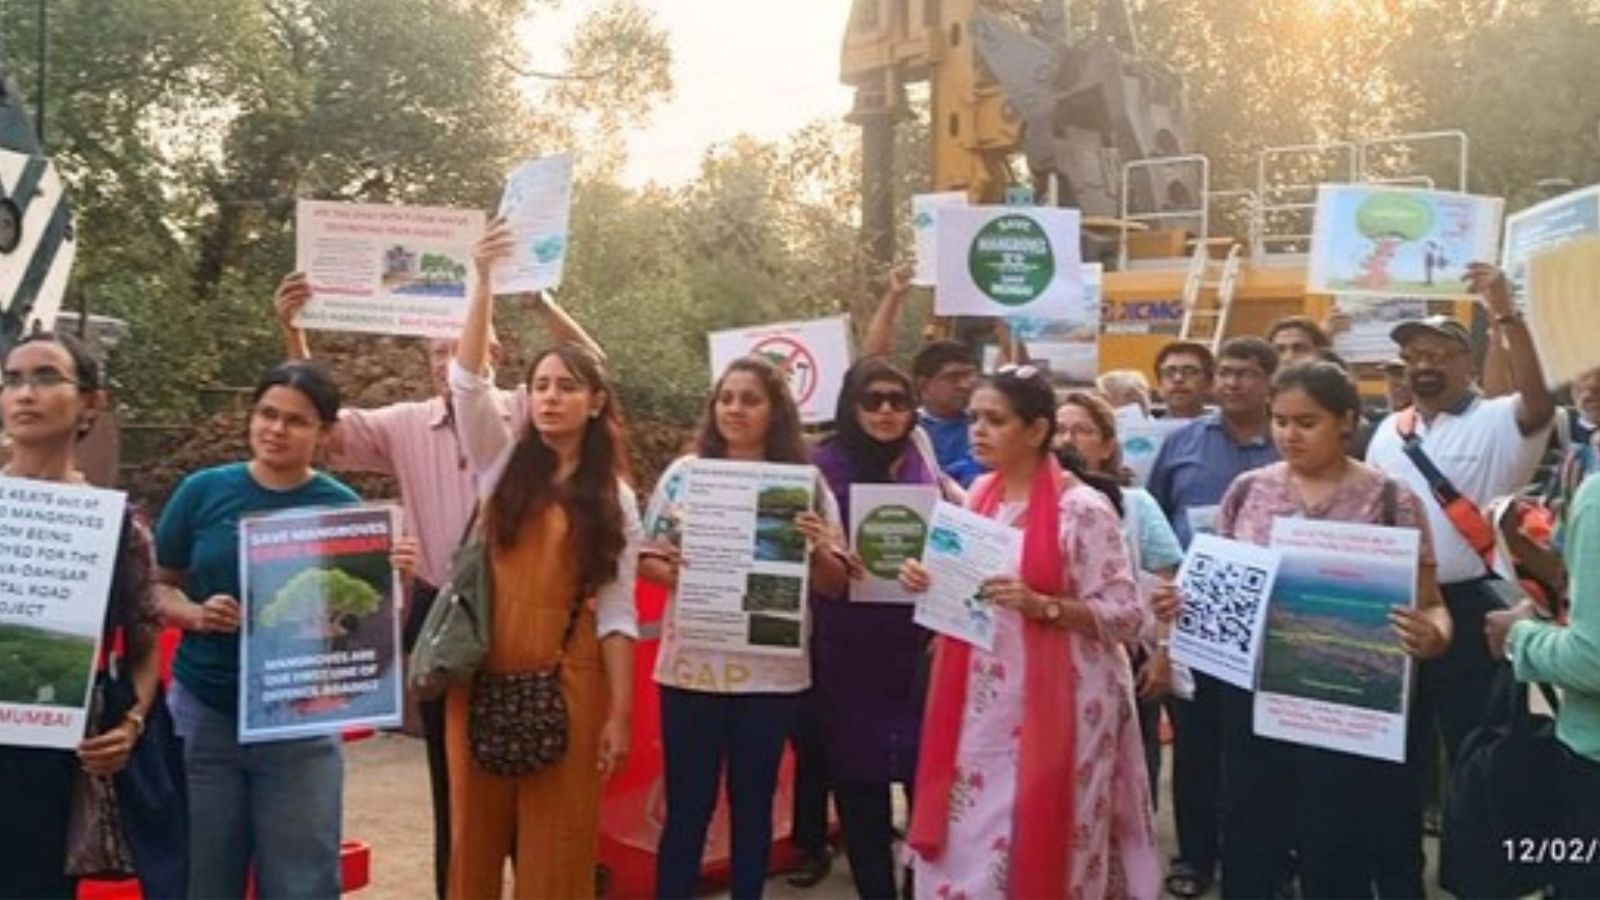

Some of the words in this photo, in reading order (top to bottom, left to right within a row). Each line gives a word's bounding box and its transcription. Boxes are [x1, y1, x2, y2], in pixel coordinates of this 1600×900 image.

[998, 221, 1031, 233] SAVE
[11, 506, 105, 530] MANGROVES
[25, 526, 73, 544] BEING
[250, 529, 290, 547] SAVE
[292, 523, 388, 541] MANGROVES
[37, 545, 67, 562] FOR
[70, 548, 100, 567] THE
[28, 584, 72, 601] ROAD
[673, 655, 750, 689] GAP
[0, 707, 72, 727] MUMBAI
